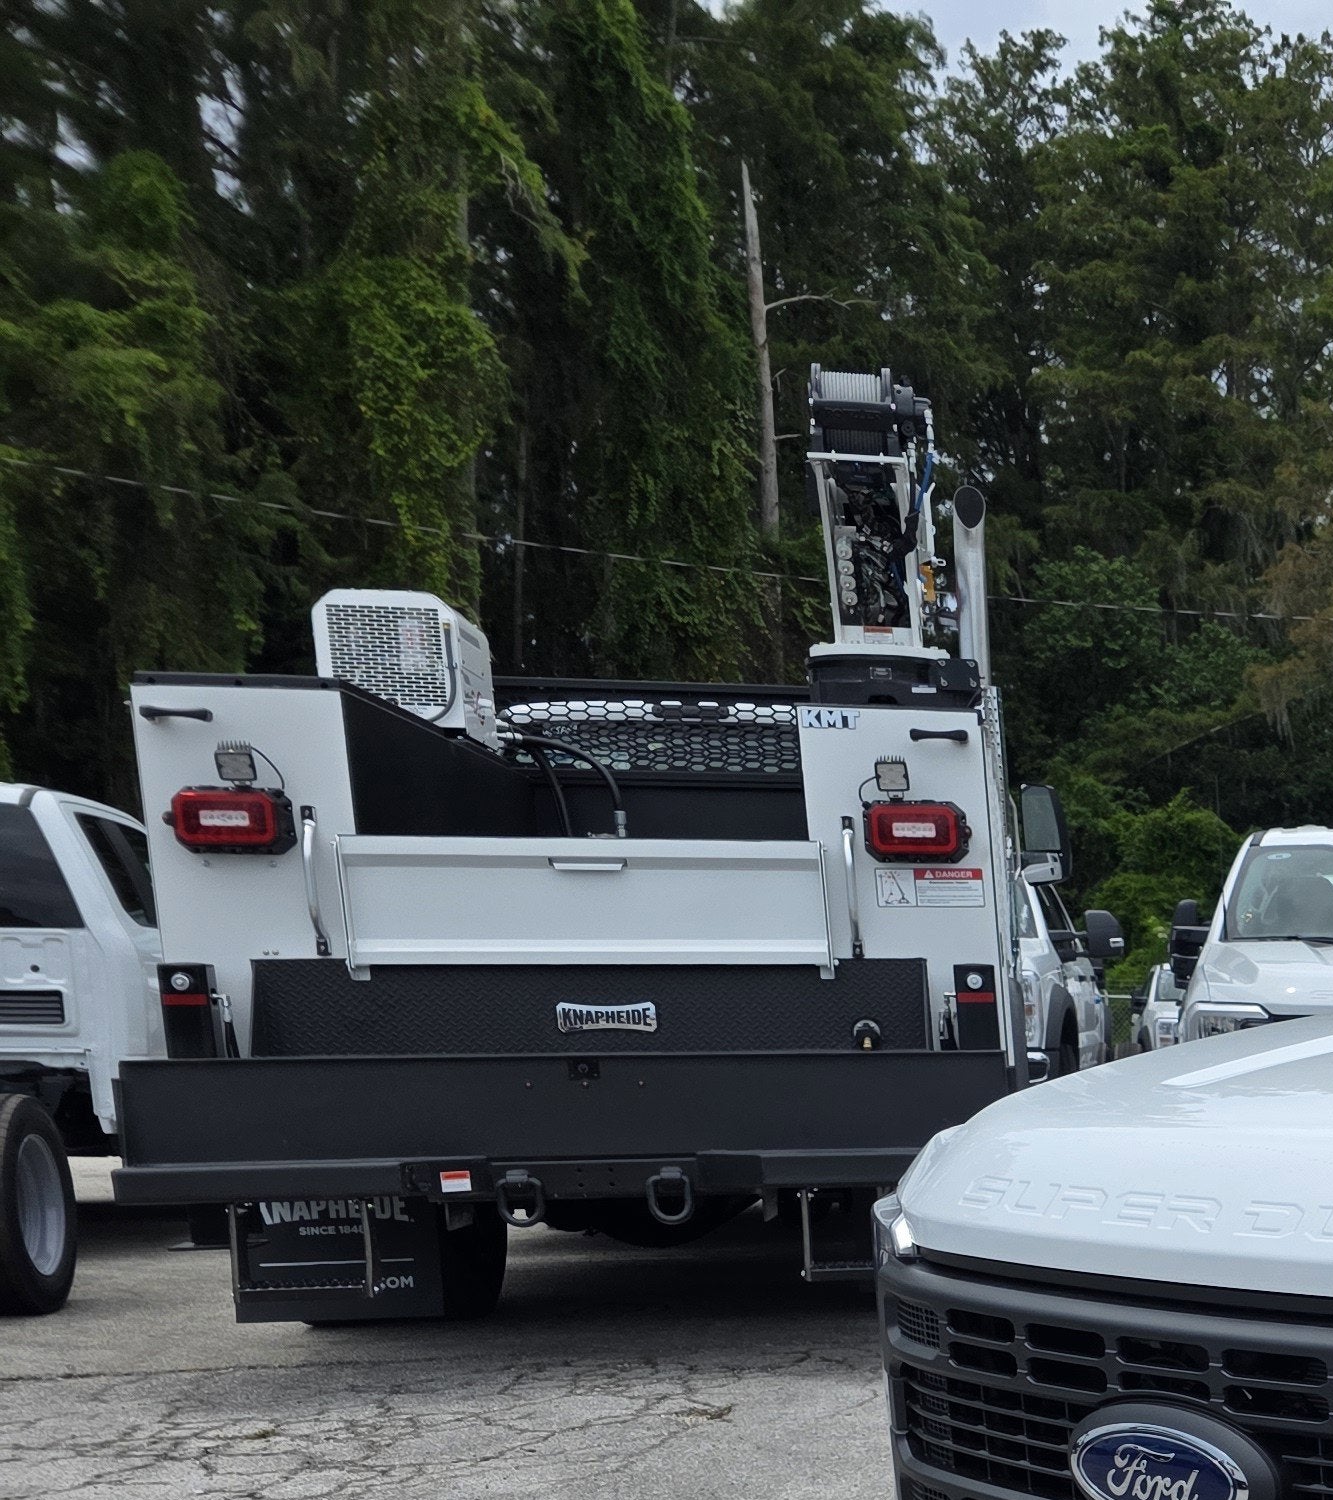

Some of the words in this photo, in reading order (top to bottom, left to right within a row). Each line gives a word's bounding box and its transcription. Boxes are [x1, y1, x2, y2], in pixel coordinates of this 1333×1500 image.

[801, 709, 860, 730] KMT
[934, 870, 973, 879] DANGER
[561, 1007, 653, 1027] KNAPHEIDE
[961, 1174, 1225, 1235] SUPER
[298, 1225, 337, 1236] SINCE
